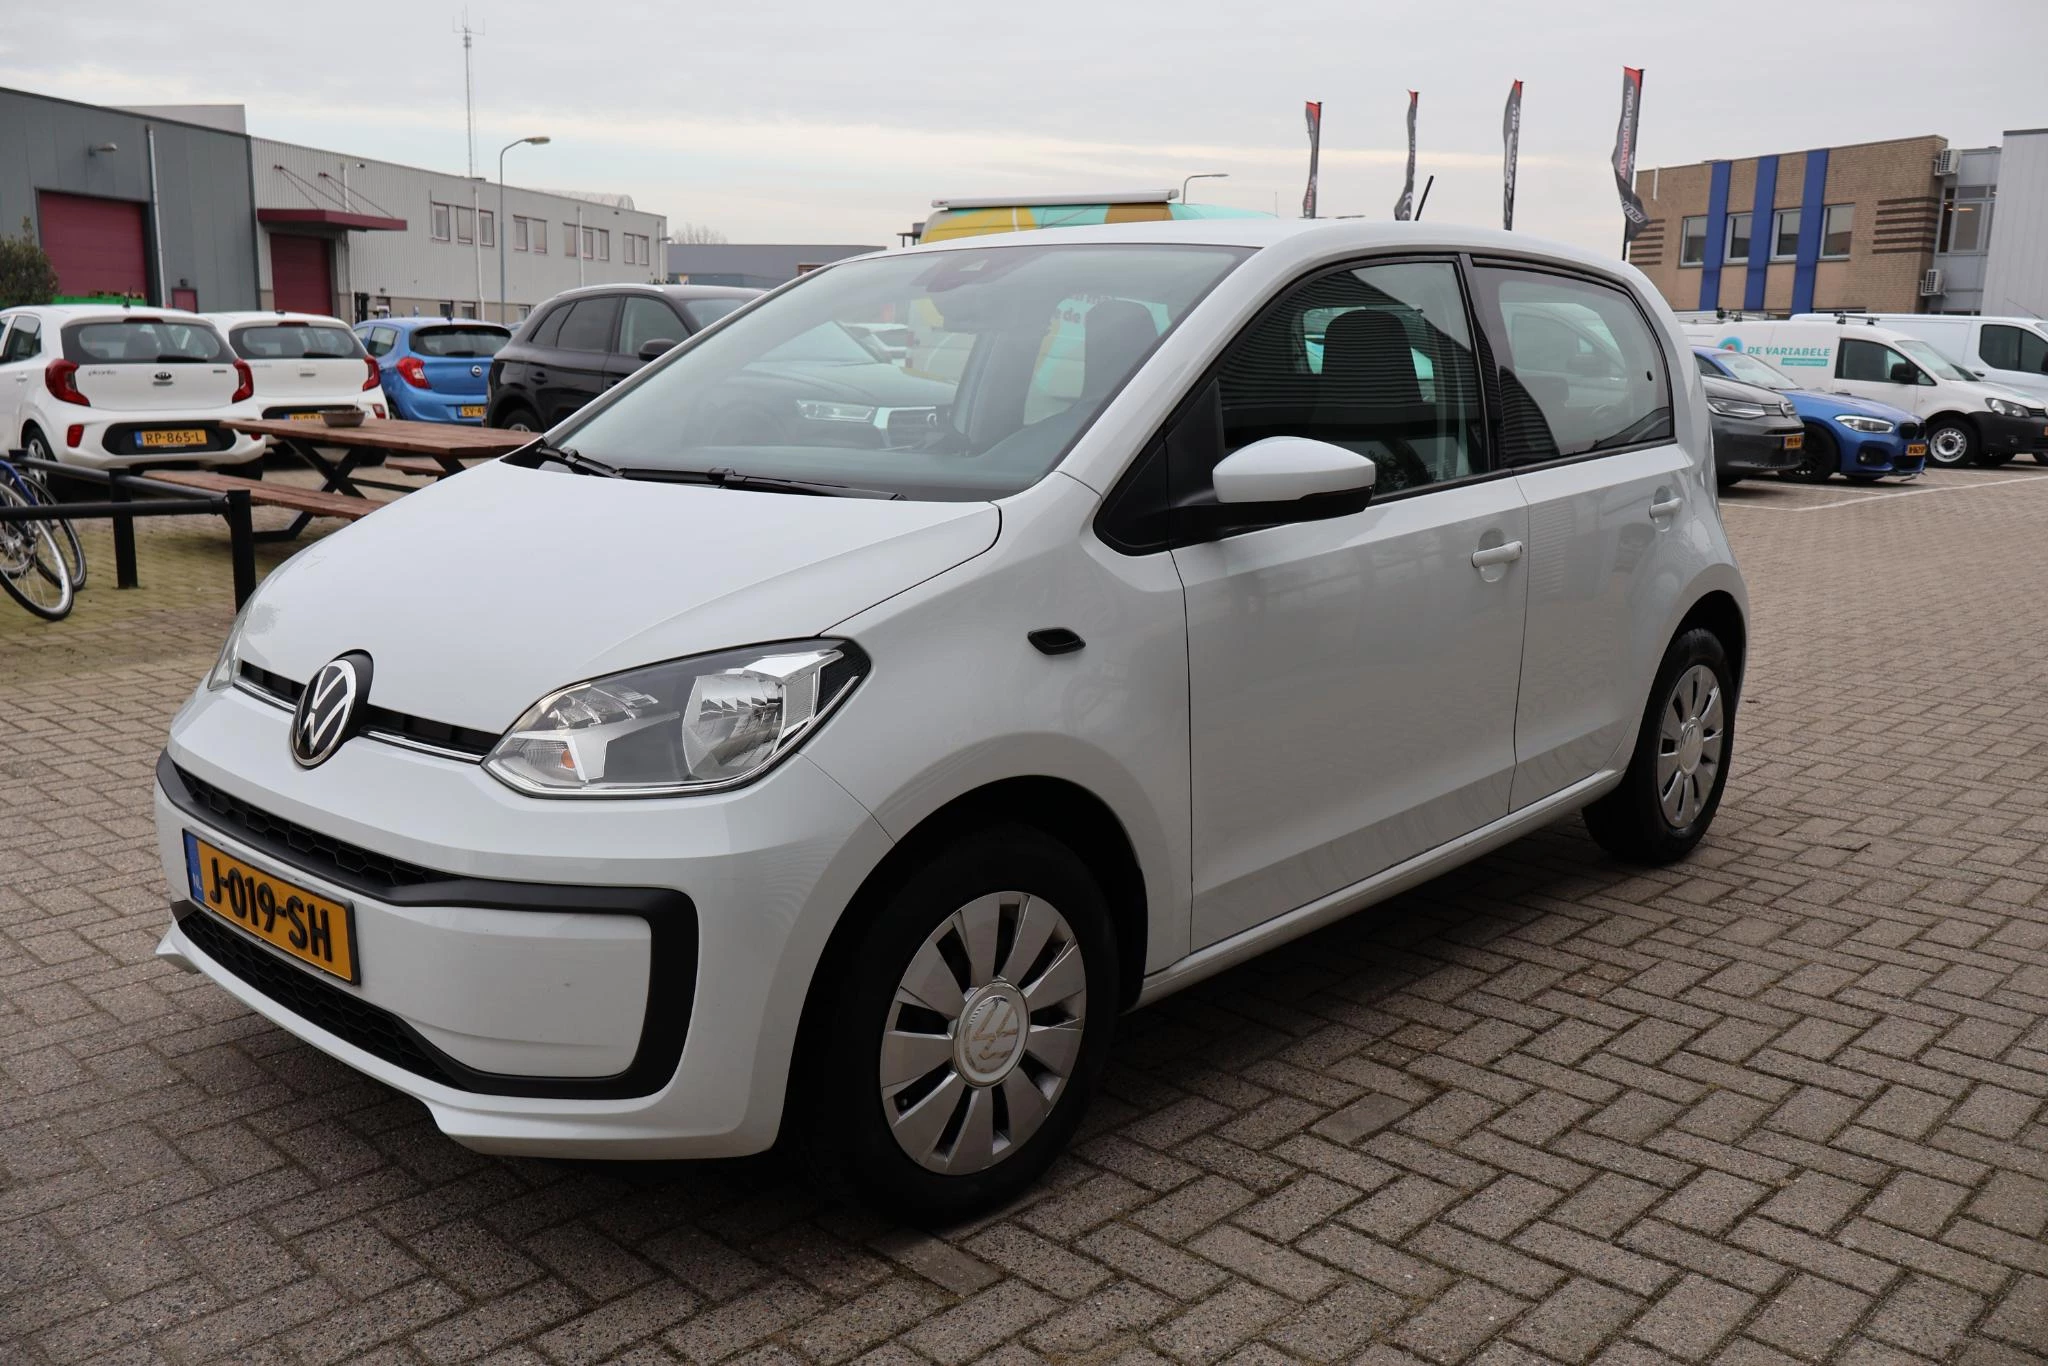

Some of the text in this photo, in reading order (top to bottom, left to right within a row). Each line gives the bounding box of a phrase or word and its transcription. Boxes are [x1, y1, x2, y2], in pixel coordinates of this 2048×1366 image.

[1747, 346, 1832, 356] DE VARIABELE
[145, 431, 202, 443] RP-865-L
[209, 856, 333, 963] J-019-SH
